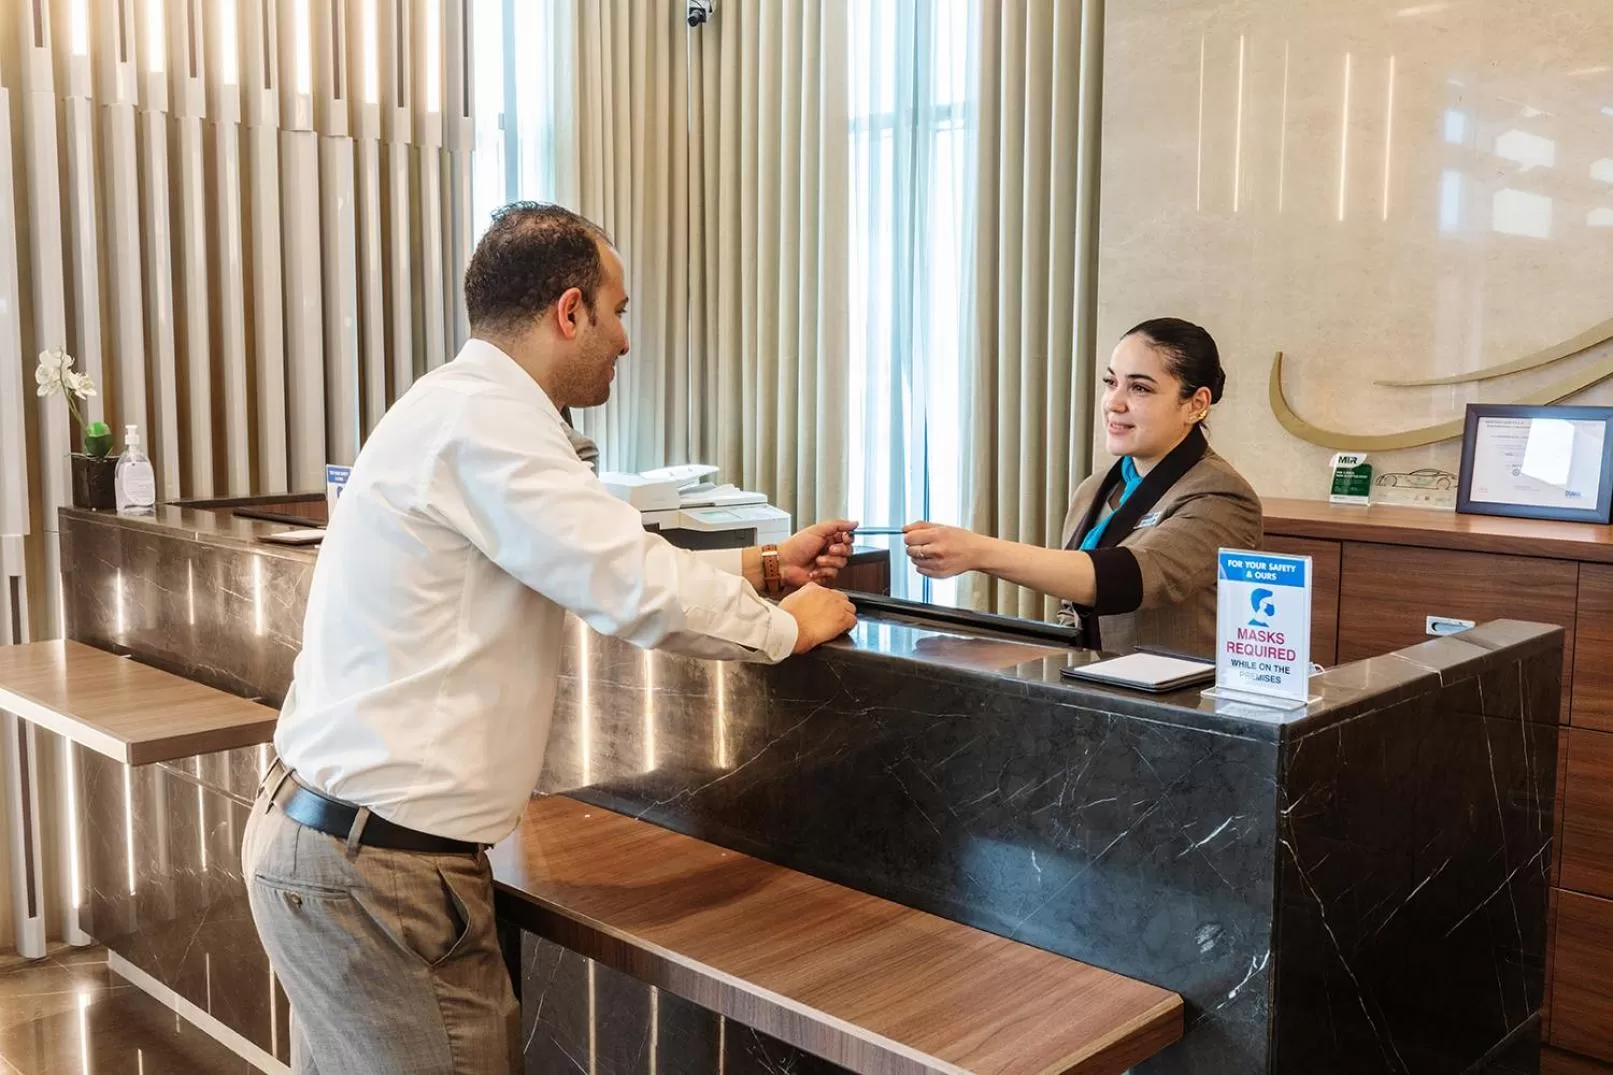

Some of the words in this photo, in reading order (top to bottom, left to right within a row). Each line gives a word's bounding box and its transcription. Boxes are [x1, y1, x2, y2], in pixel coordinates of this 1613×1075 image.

[1227, 559, 1243, 568] FOR
[1245, 561, 1267, 570] YOUR
[1268, 563, 1297, 572] SAFETY
[1245, 570, 1253, 578] &
[1254, 572, 1277, 581] OURS
[1237, 627, 1285, 645] MASKS
[1226, 641, 1296, 661] REQUIRED
[1231, 659, 1257, 670] WHILE
[1258, 663, 1272, 671] ON
[1274, 665, 1291, 674] THE
